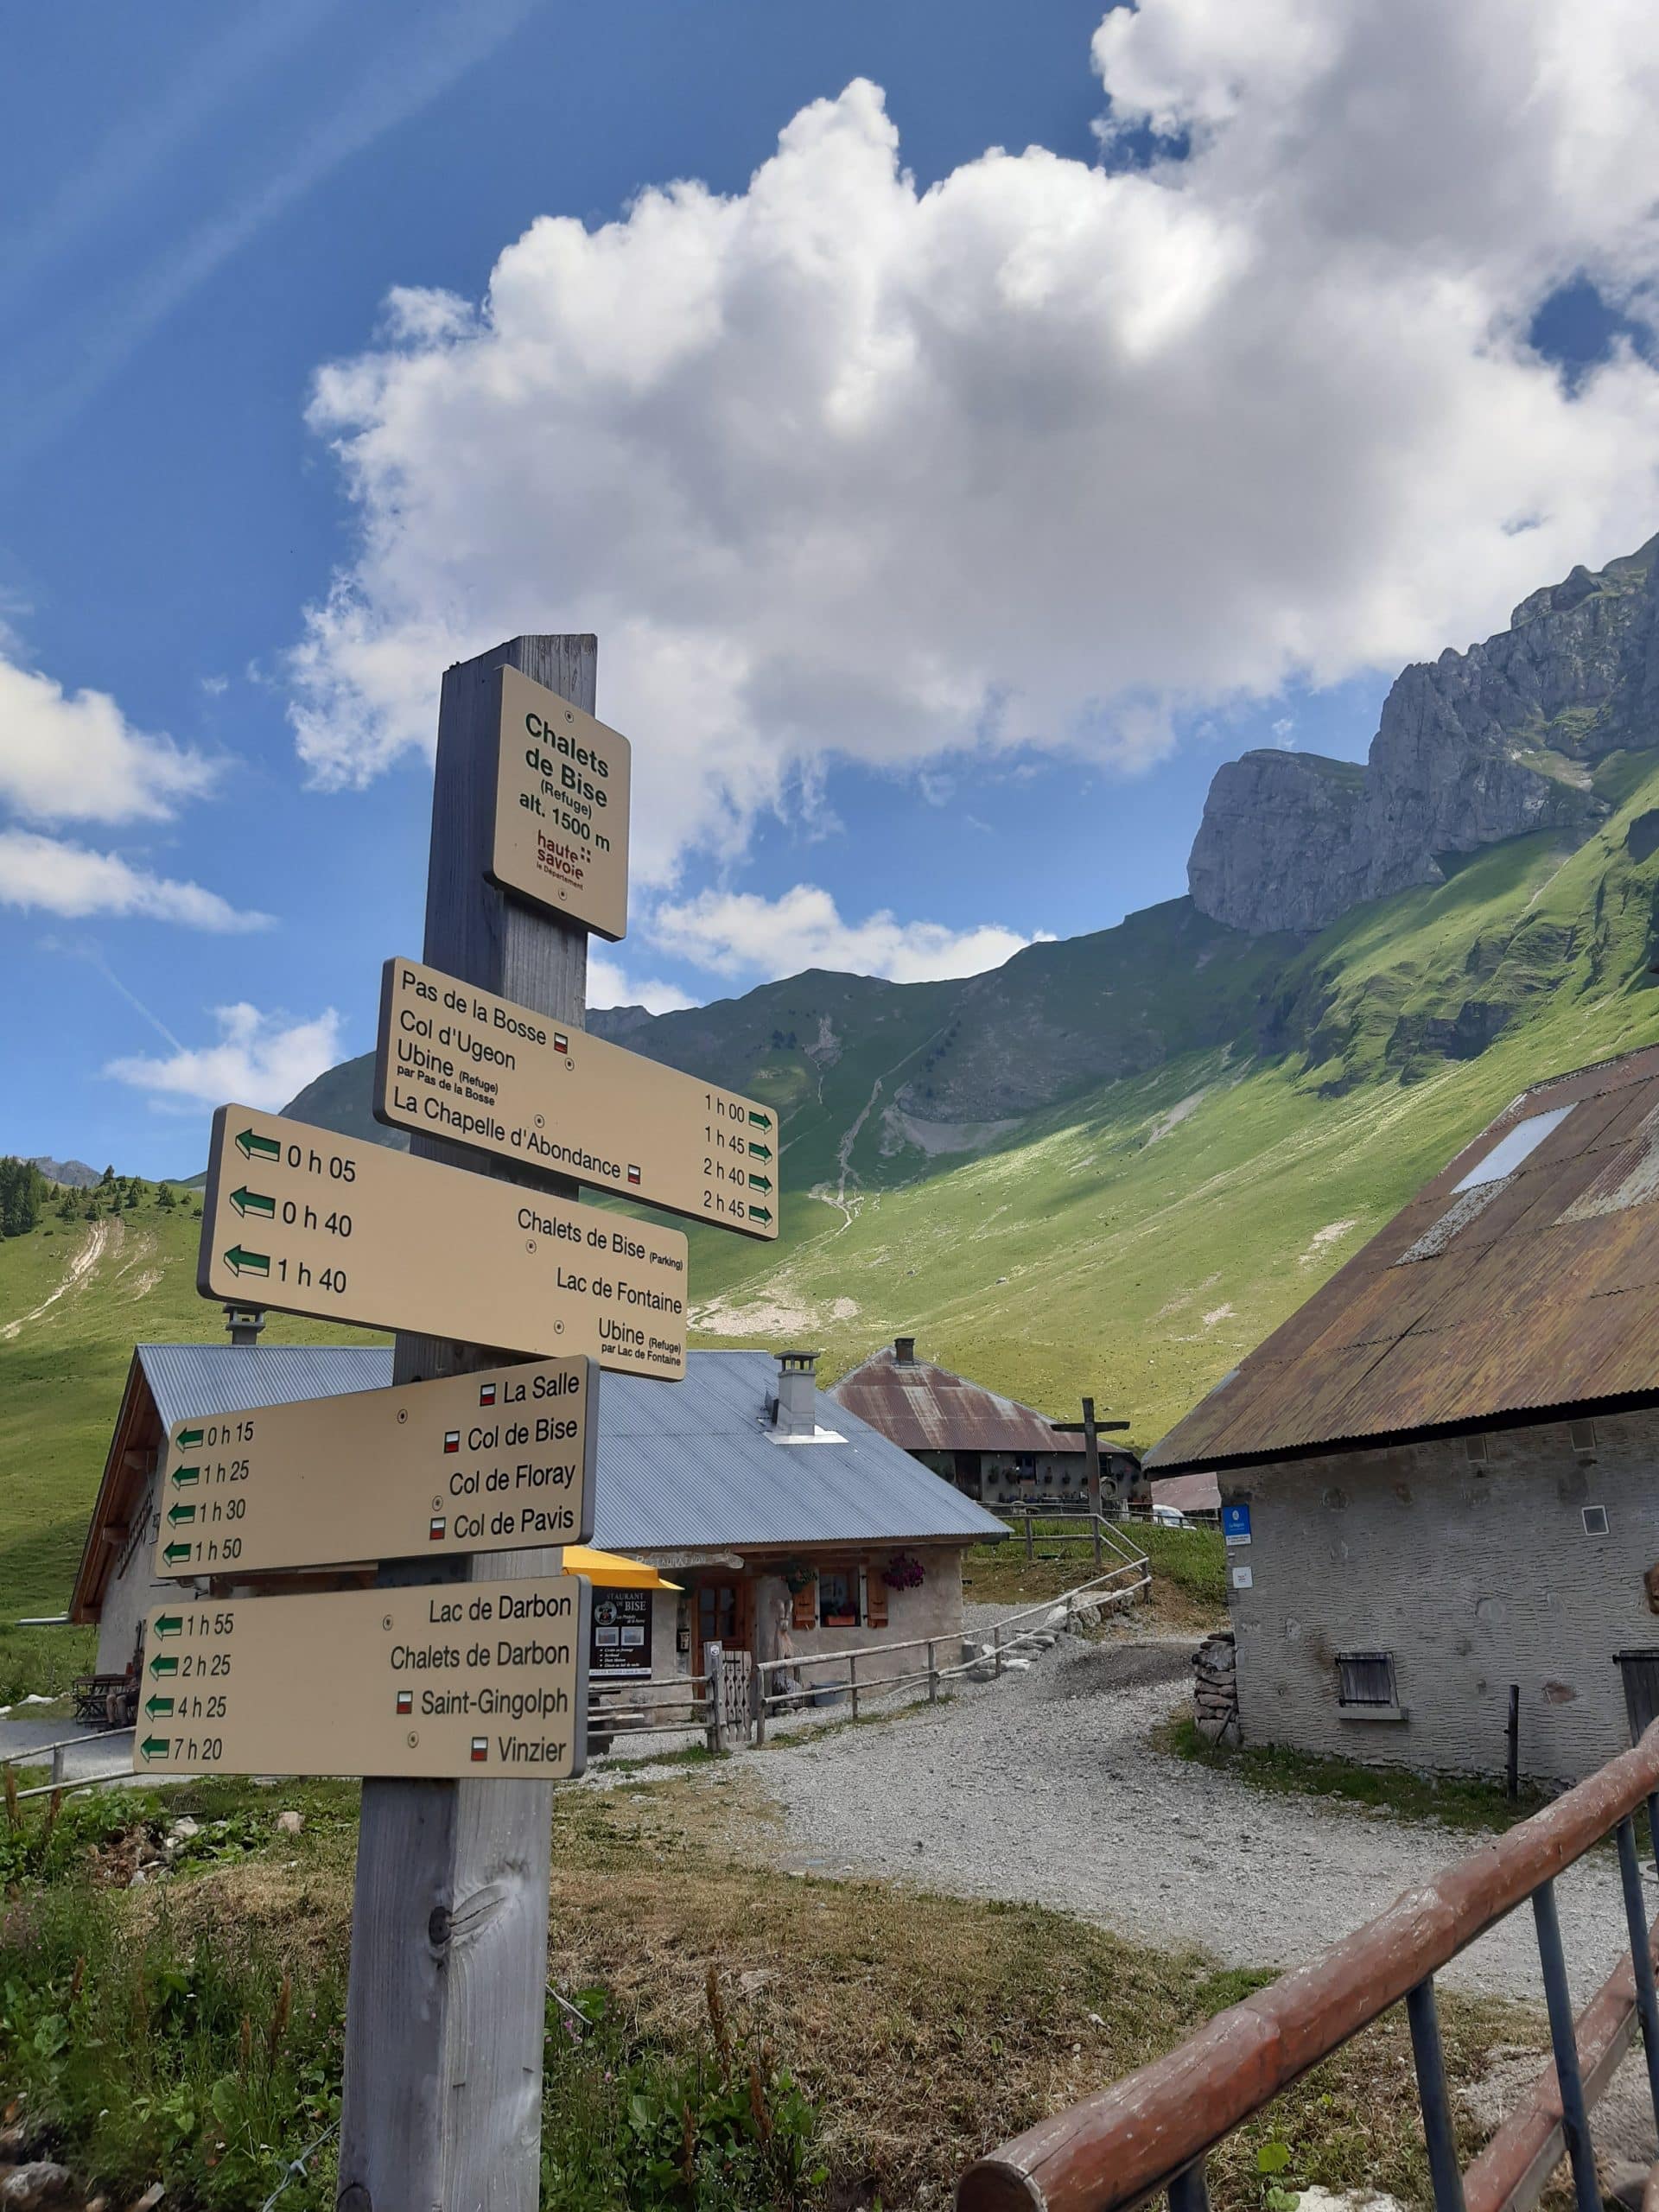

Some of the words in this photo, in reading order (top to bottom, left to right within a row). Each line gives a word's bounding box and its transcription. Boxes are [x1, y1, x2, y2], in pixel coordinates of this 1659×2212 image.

[525, 713, 608, 778] Chalets
[525, 747, 553, 777] de
[562, 763, 607, 807] Bise
[541, 779, 592, 820] (Refuge)
[519, 793, 545, 817] alt.
[552, 808, 590, 840] 1500
[595, 834, 610, 853] m
[537, 830, 578, 863] haute
[537, 849, 583, 880] savoie
[403, 970, 437, 1001] Pas
[443, 990, 467, 1014] de
[473, 999, 487, 1023] la
[493, 1007, 546, 1046] Bosse
[400, 1010, 432, 1039] Col
[439, 1026, 515, 1071] d'Ugeon
[397, 1039, 454, 1077] Ubine
[459, 1071, 498, 1096] (Refuge)
[397, 1065, 415, 1077] par
[417, 1070, 435, 1085] Pas
[439, 1079, 451, 1090] de
[454, 1083, 462, 1096] la
[465, 1086, 495, 1106] Bosse
[705, 1094, 710, 1110] 1
[717, 1097, 724, 1116] h
[729, 1103, 745, 1122] 00
[394, 1085, 417, 1113] La
[424, 1097, 505, 1141] Chapelle
[511, 1128, 620, 1178] d'Abondance
[705, 1126, 710, 1142] 1
[717, 1129, 724, 1147] h
[728, 1135, 745, 1154] 45
[288, 1145, 302, 1168] 0
[308, 1149, 321, 1174] h
[330, 1157, 356, 1182] 05
[703, 1158, 712, 1175] 2
[716, 1161, 724, 1179] h
[728, 1167, 745, 1186] 40
[283, 1201, 296, 1224] 0
[304, 1205, 317, 1230] h
[325, 1212, 352, 1237] 40
[703, 1190, 712, 1208] 2
[716, 1193, 724, 1212] h
[728, 1199, 745, 1218] 45
[518, 1208, 582, 1243] Chalets
[587, 1228, 607, 1249] de
[613, 1233, 645, 1259] Bise
[649, 1252, 683, 1271] (Parking)
[278, 1258, 287, 1282] 1
[298, 1262, 311, 1287] h
[319, 1268, 346, 1294] 40
[557, 1267, 587, 1293] Lac
[592, 1277, 613, 1299] de
[618, 1281, 682, 1314] Fontaine
[599, 1318, 645, 1345] Ubine
[649, 1337, 682, 1355] (Refuge)
[601, 1344, 616, 1354] par
[618, 1344, 632, 1357] Lac
[635, 1350, 645, 1359] de
[647, 1351, 681, 1366] Fontaine
[504, 1382, 526, 1403] La
[532, 1372, 580, 1399] Salle
[208, 1427, 217, 1446] 0
[221, 1425, 230, 1445] h
[237, 1421, 254, 1442] 15
[468, 1425, 499, 1451] Col
[505, 1422, 529, 1446] de
[536, 1417, 577, 1442] Bise
[204, 1465, 210, 1484] 1
[216, 1463, 226, 1483] h
[230, 1459, 249, 1481] 25
[449, 1471, 480, 1496] Col
[486, 1468, 510, 1491] de
[516, 1464, 575, 1490] Floray
[200, 1503, 207, 1522] 1
[213, 1501, 221, 1522] h
[226, 1498, 245, 1520] 30
[454, 1513, 485, 1538] Col
[491, 1511, 514, 1535] de
[521, 1505, 574, 1532] Pavis
[196, 1541, 202, 1561] 1
[208, 1540, 218, 1560] h
[222, 1537, 242, 1560] 50
[429, 1599, 462, 1623] Lac
[469, 1597, 493, 1621] de
[499, 1593, 571, 1619] Darbon
[625, 1600, 646, 1611] BISE
[188, 1615, 194, 1636] 1
[200, 1614, 209, 1636] h
[214, 1613, 234, 1635] 55
[182, 1656, 193, 1677] 2
[197, 1655, 207, 1676] h
[210, 1654, 231, 1676] 25
[391, 1645, 460, 1670] Chalets
[467, 1643, 491, 1667] de
[498, 1640, 569, 1666] Darbon
[178, 1696, 188, 1718] 4
[193, 1696, 202, 1718] h
[207, 1696, 226, 1718] 25
[422, 1688, 568, 1720] Saint-Gingolph
[175, 1738, 184, 1760] 7
[188, 1738, 197, 1760] h
[201, 1738, 222, 1760] 20
[498, 1736, 567, 1762] Vinzier
